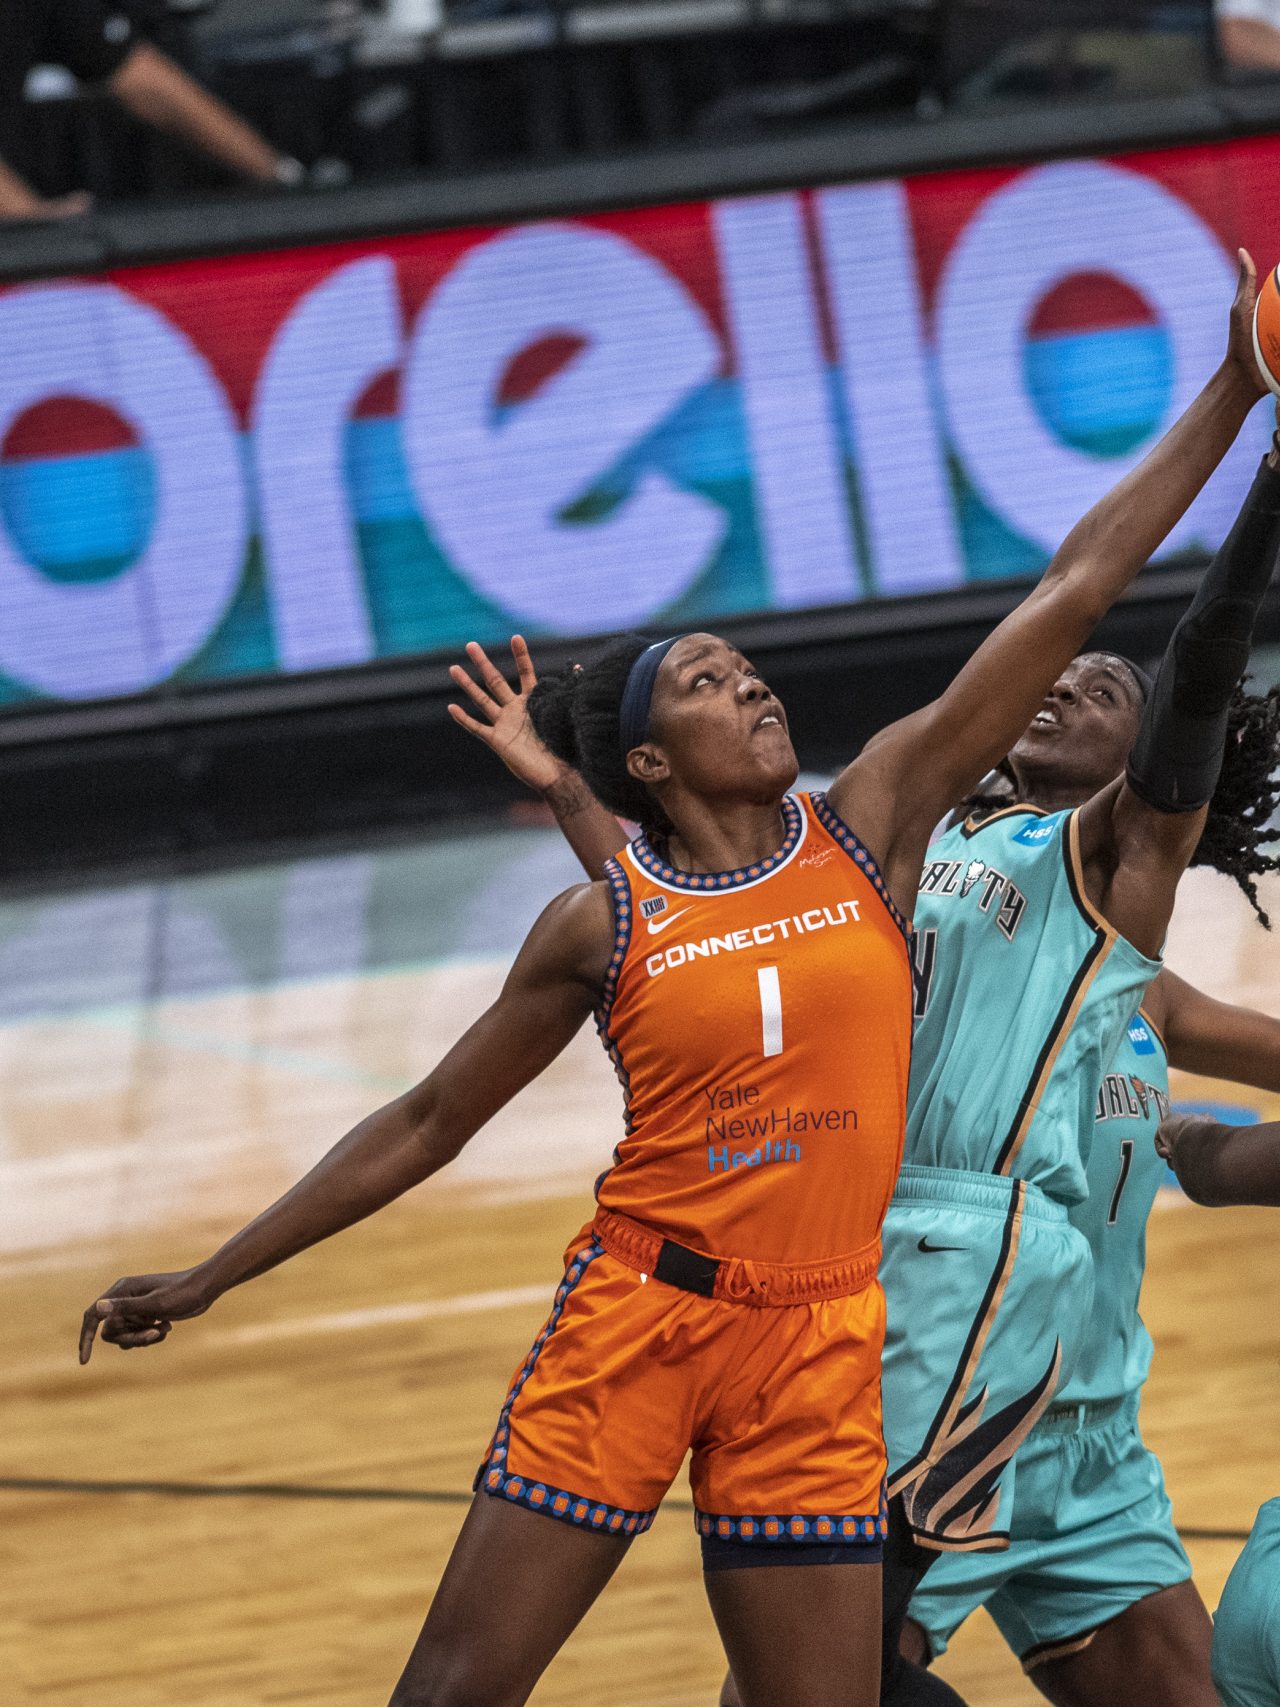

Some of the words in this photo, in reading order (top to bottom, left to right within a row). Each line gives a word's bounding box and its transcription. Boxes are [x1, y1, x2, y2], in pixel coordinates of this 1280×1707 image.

[1023, 825, 1053, 840] HSS
[646, 900, 861, 977] CONNECTICUT
[757, 966, 783, 1057] 1
[1128, 1028, 1148, 1042] HSS
[705, 1082, 760, 1110] Yale
[706, 1107, 858, 1143] NewHaven
[708, 1137, 800, 1173] Health
[1107, 1139, 1134, 1225] 1
